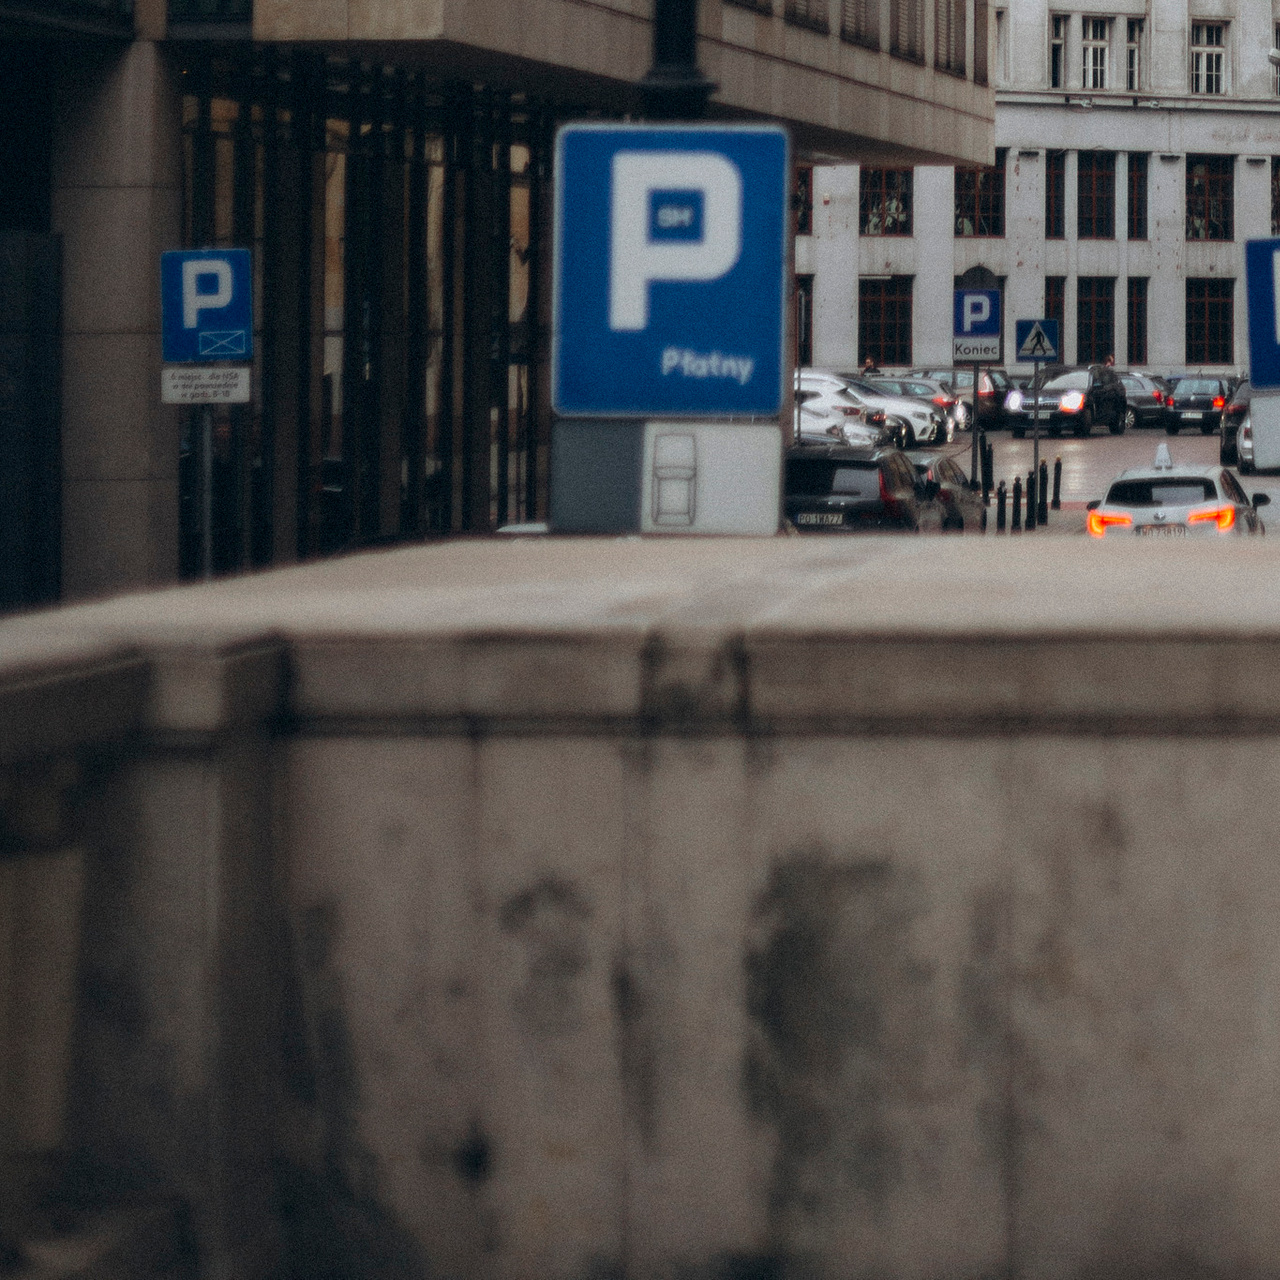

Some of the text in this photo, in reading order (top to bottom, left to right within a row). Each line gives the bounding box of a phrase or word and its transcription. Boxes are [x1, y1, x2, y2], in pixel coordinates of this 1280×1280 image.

[609, 150, 742, 332] P
[182, 259, 233, 329] P
[963, 295, 990, 332] P
[955, 343, 998, 356] Koniec
